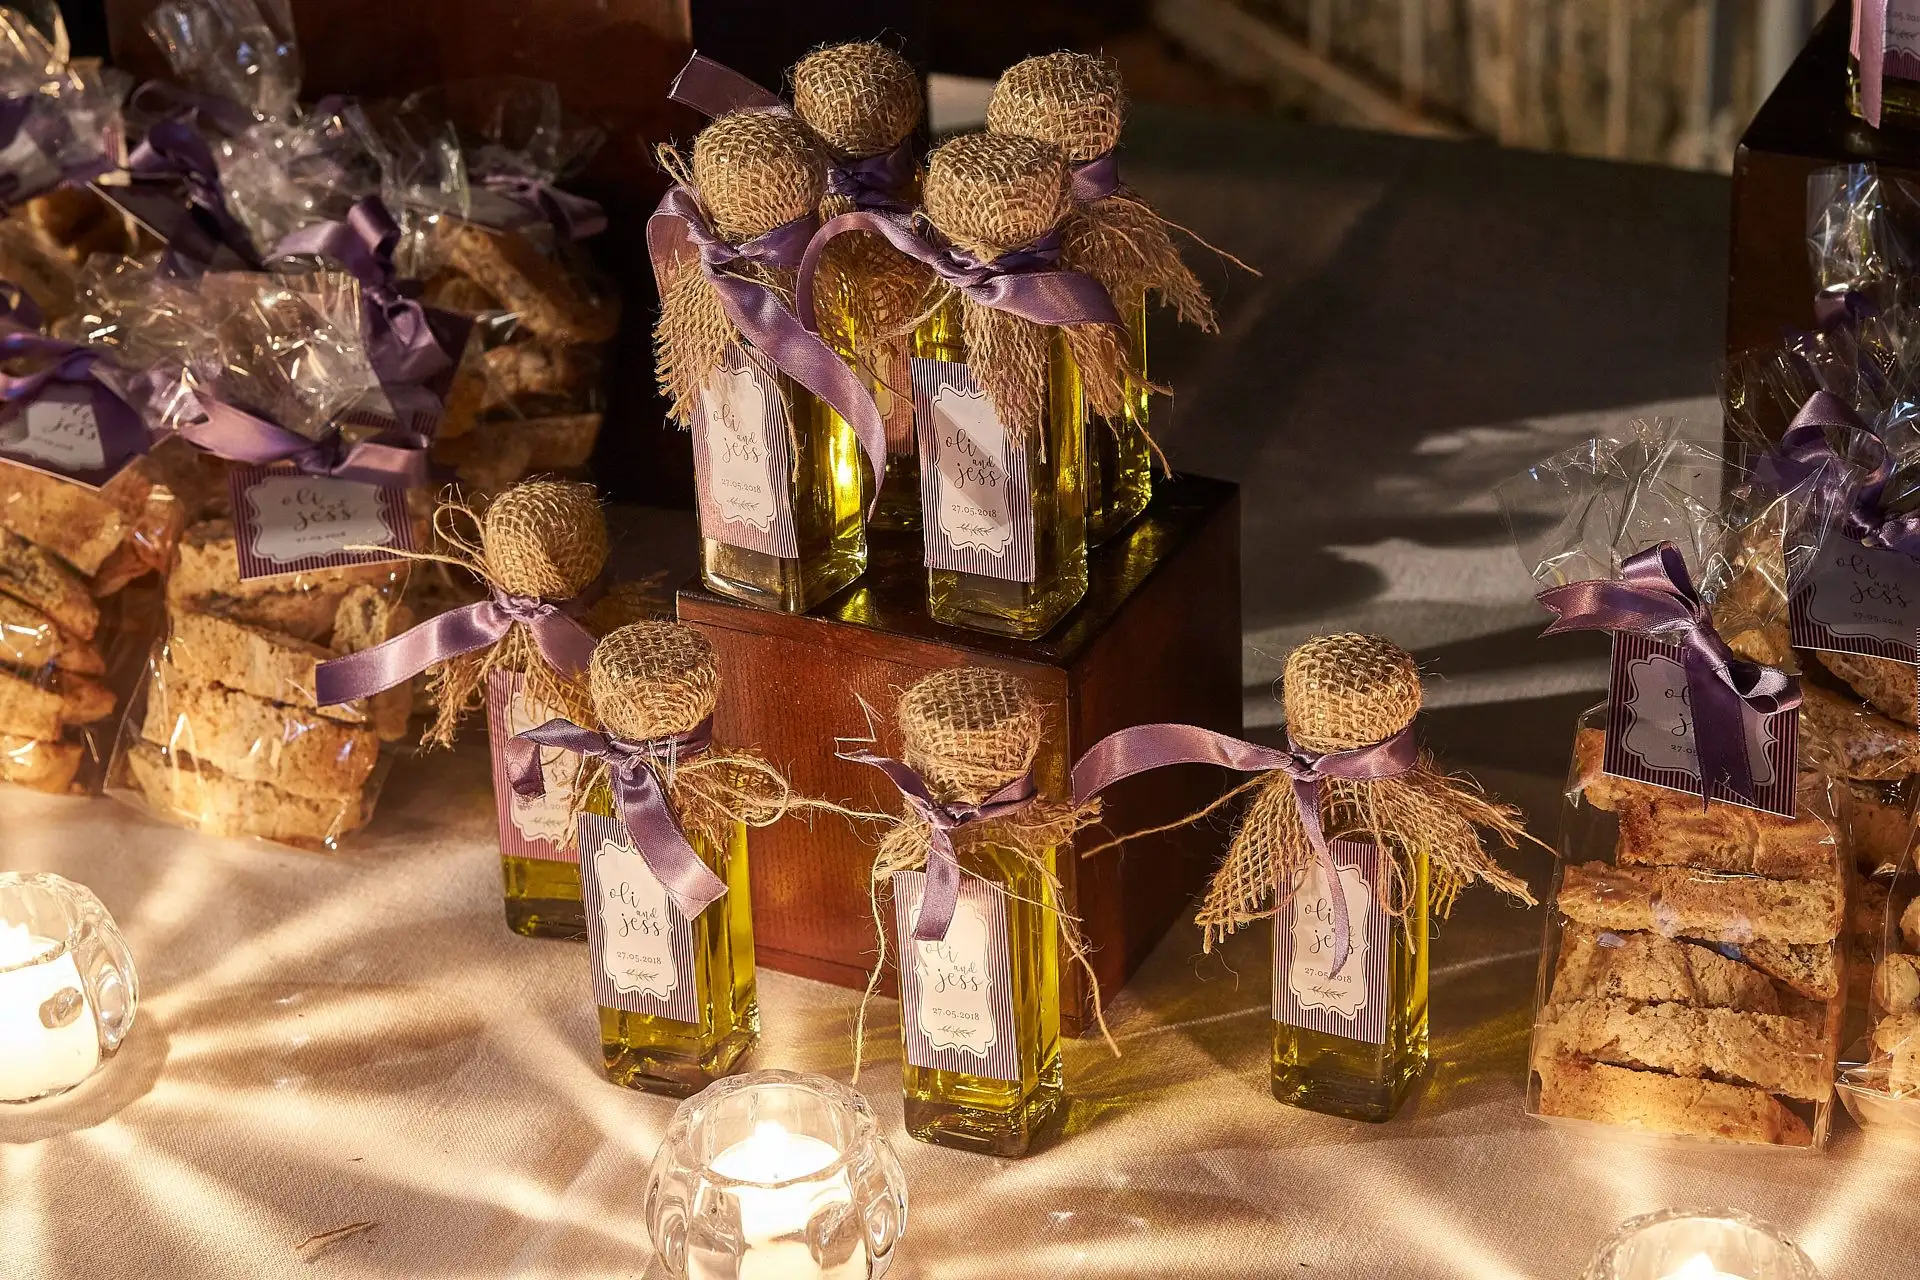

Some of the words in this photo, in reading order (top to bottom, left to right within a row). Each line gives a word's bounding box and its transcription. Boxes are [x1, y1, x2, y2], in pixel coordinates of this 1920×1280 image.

[713, 403, 741, 432] oli
[721, 437, 763, 464] jess
[736, 431, 758, 446] and
[945, 428, 977, 457] oli
[972, 455, 996, 471] and
[721, 478, 762, 494] 27.05.2018
[953, 462, 1002, 490] jess
[951, 504, 997, 519] 27.05.2018
[1836, 553, 1879, 580] oli
[610, 881, 640, 909] oli
[636, 907, 659, 921] and
[1304, 897, 1336, 926] oli
[618, 913, 665, 938] jess
[616, 951, 662, 966] 27.05.2018
[925, 939, 959, 964] oli
[934, 968, 984, 994] jess
[953, 961, 978, 976] and
[932, 1007, 980, 1021] 27.05.2018
